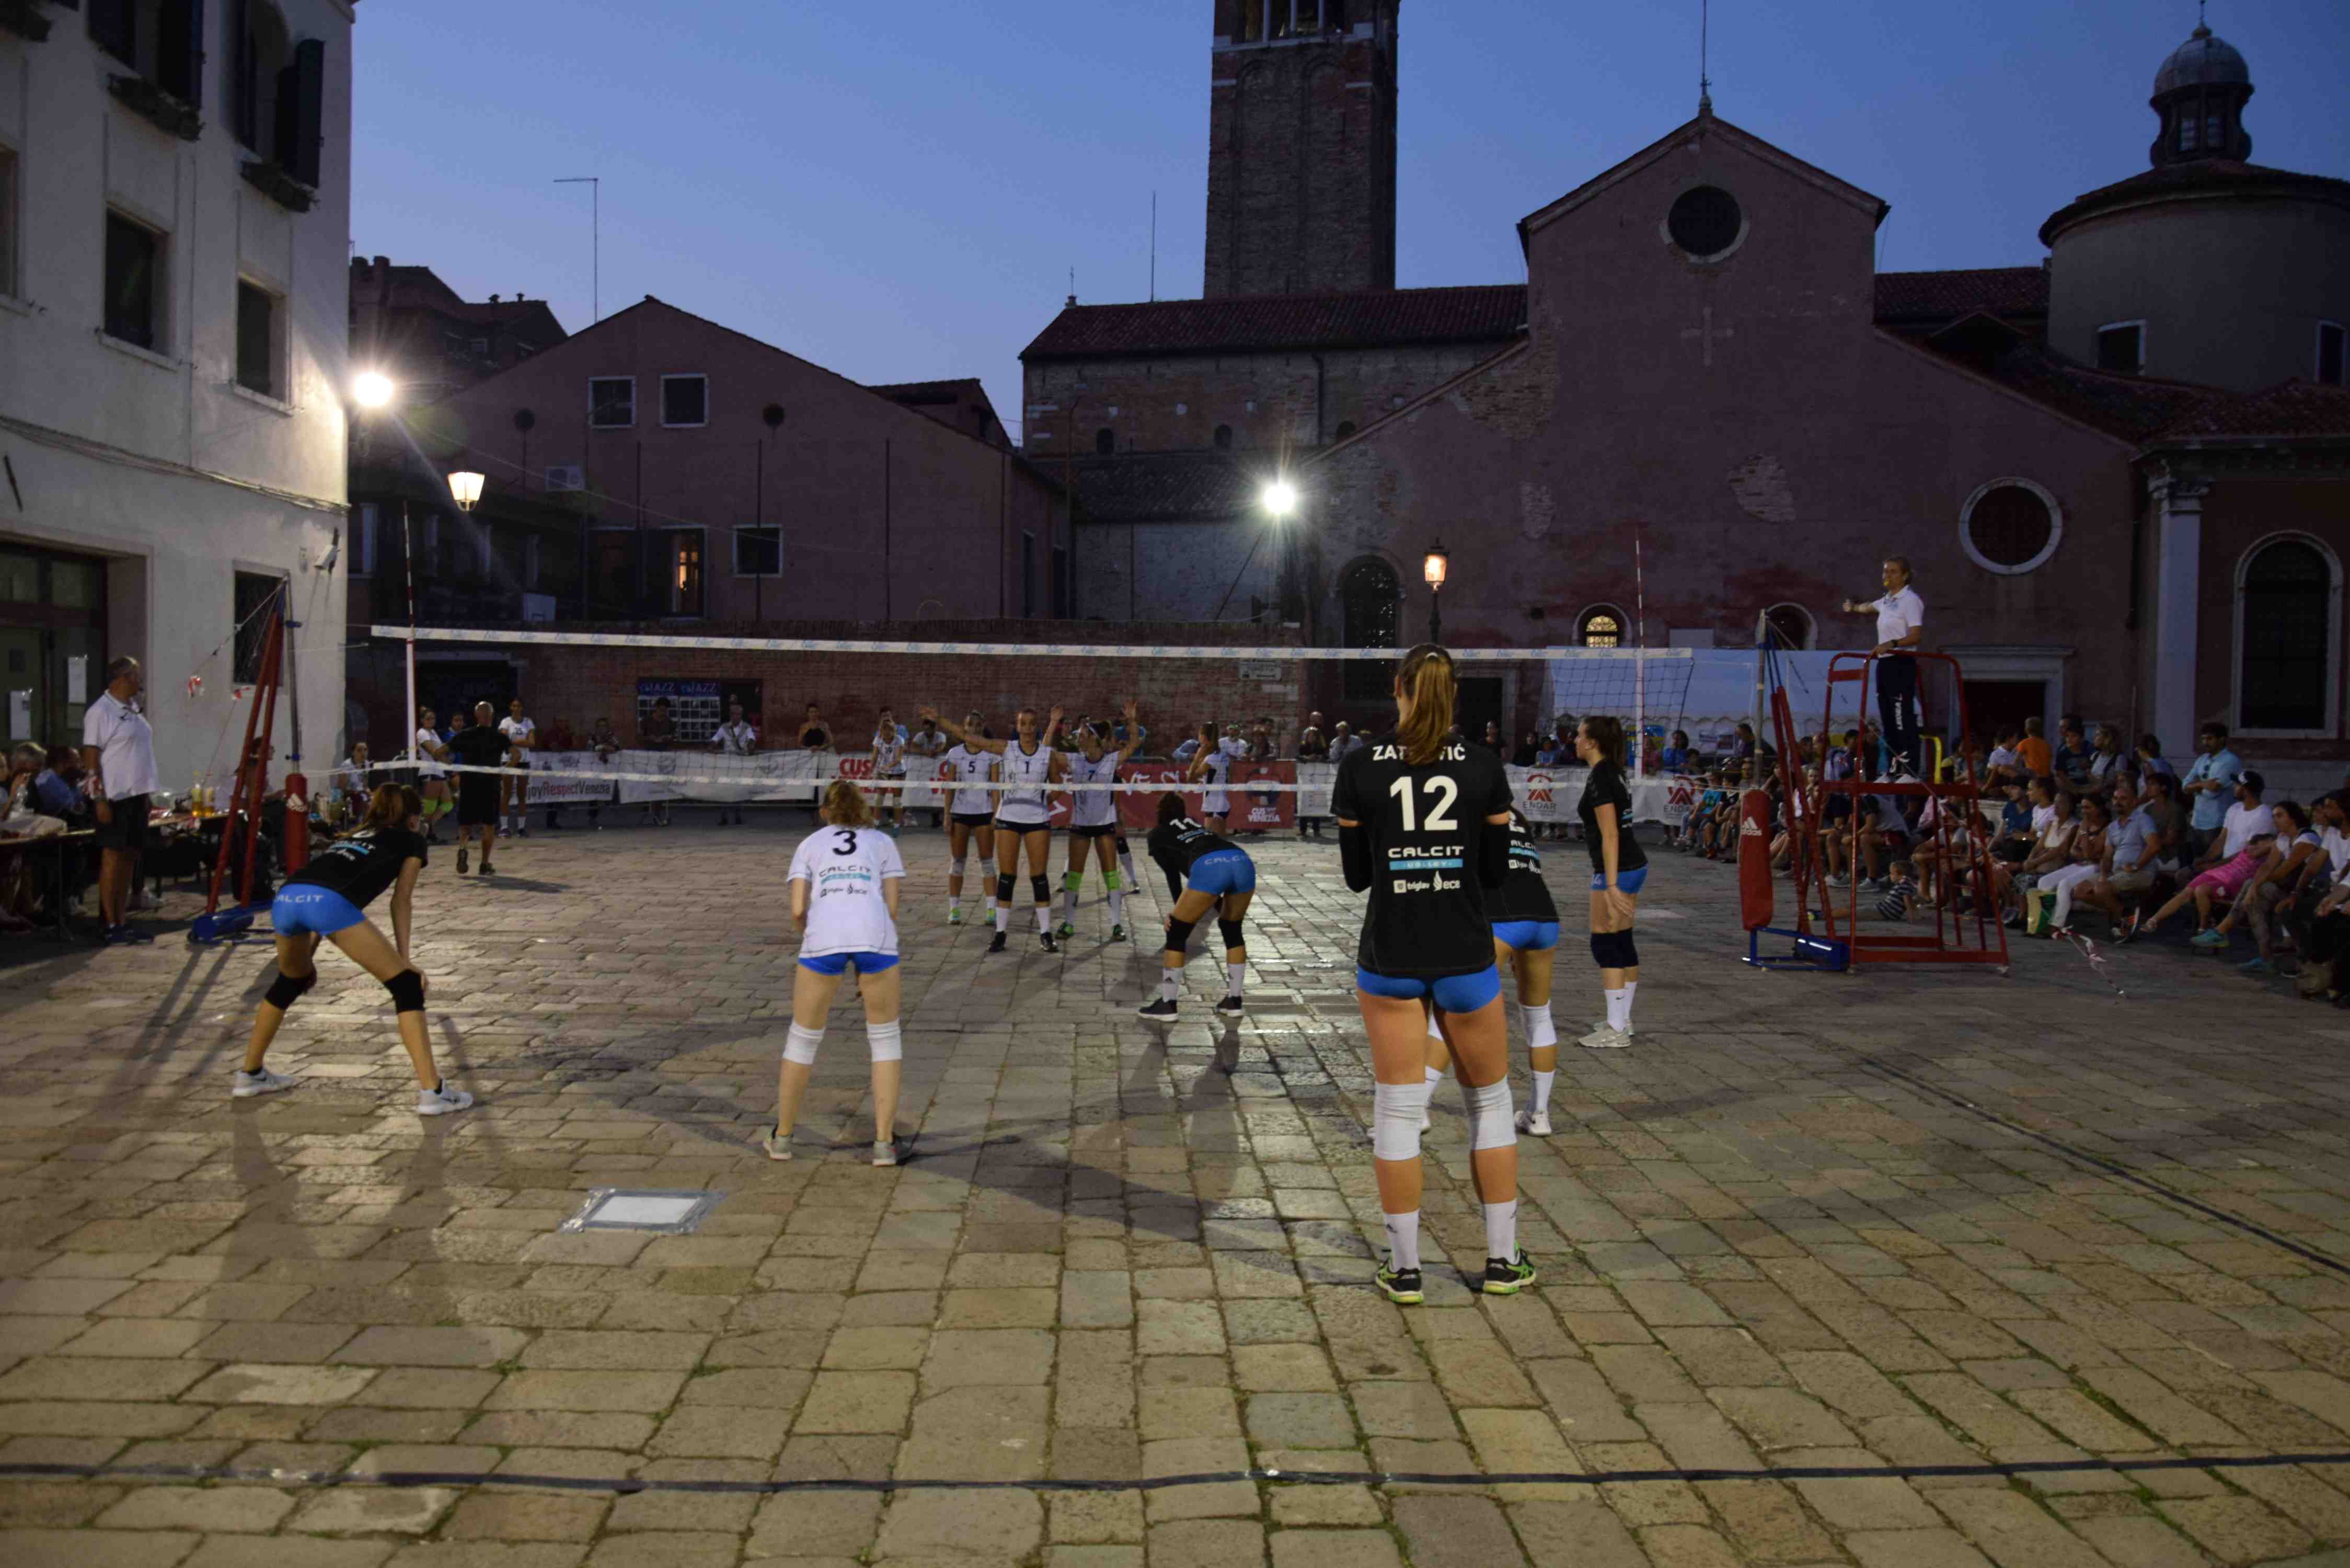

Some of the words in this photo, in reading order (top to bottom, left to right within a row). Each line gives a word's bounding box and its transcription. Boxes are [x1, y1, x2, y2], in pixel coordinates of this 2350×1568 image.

[968, 761, 975, 774] 5
[1024, 761, 1029, 774] 1
[1089, 770, 1096, 781] 7
[1389, 775, 1458, 832] 12
[1523, 801, 1557, 810] ENDAR
[832, 829, 857, 856] 3
[1388, 846, 1464, 858] CALCIT
